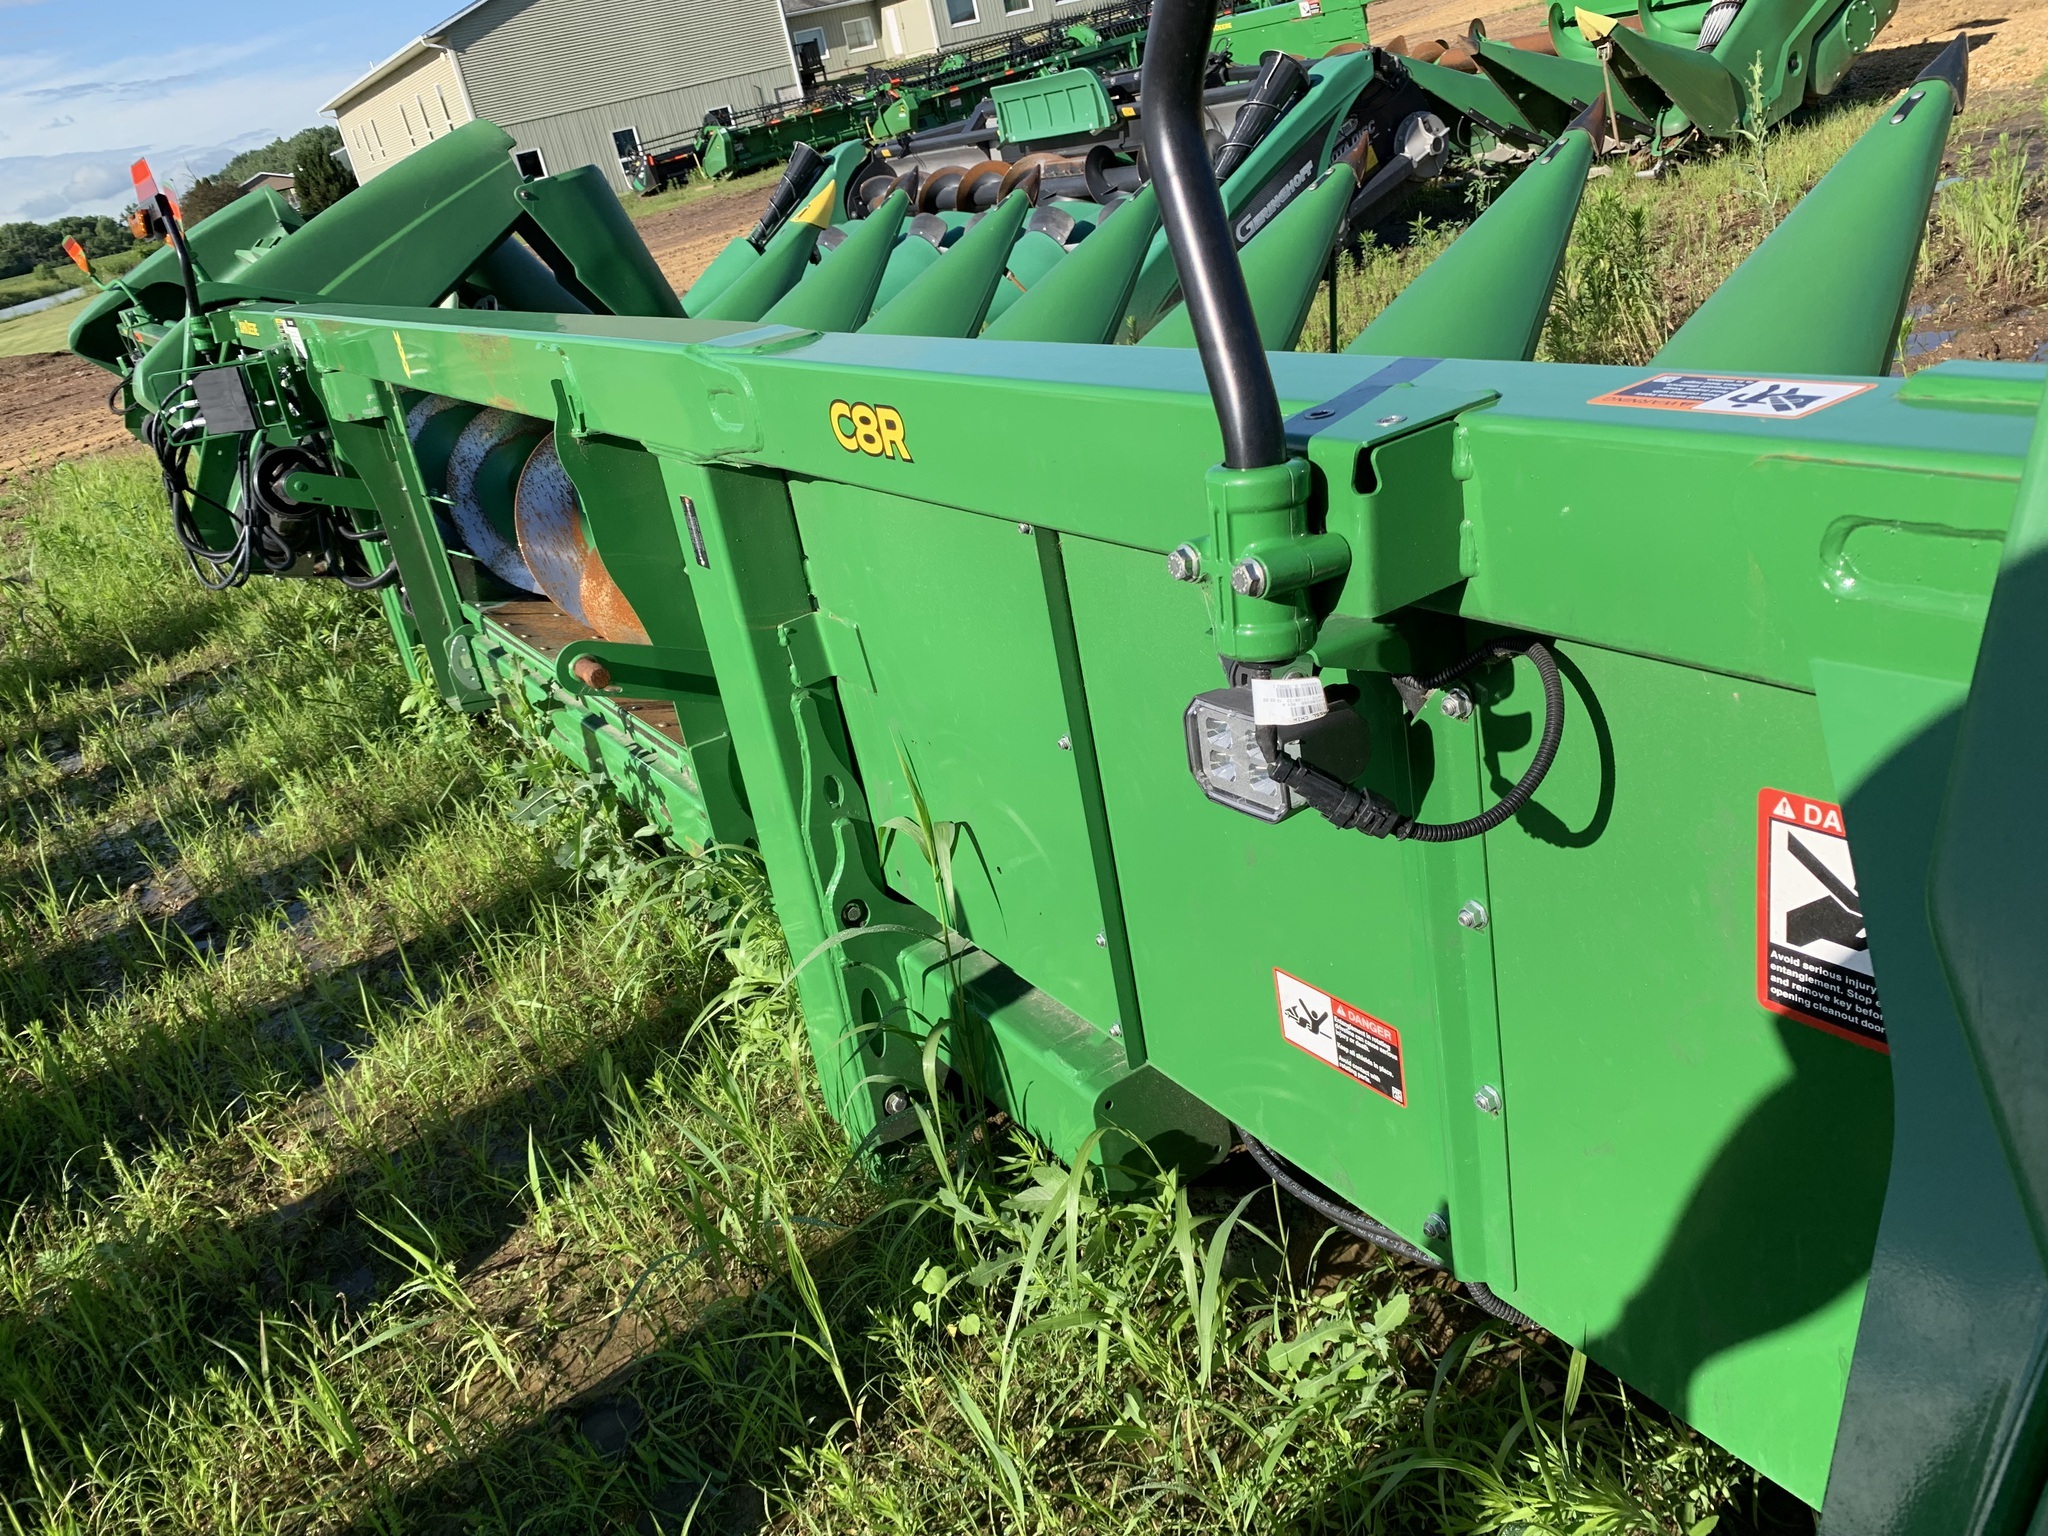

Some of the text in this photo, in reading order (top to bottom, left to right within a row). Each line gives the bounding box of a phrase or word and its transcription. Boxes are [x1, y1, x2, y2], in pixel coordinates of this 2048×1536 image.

[829, 399, 915, 464] C8R
[1770, 950, 1877, 994] Avoid serious injury
[1770, 963, 1872, 1005] entanglement. Stop
[1770, 974, 1789, 986] and
[1792, 983, 1830, 1002] remove
[1833, 996, 1852, 1010] key
[1770, 987, 1811, 1008] opening
[1812, 1002, 1859, 1024] cleanout
[1348, 1011, 1391, 1041] DANGER
